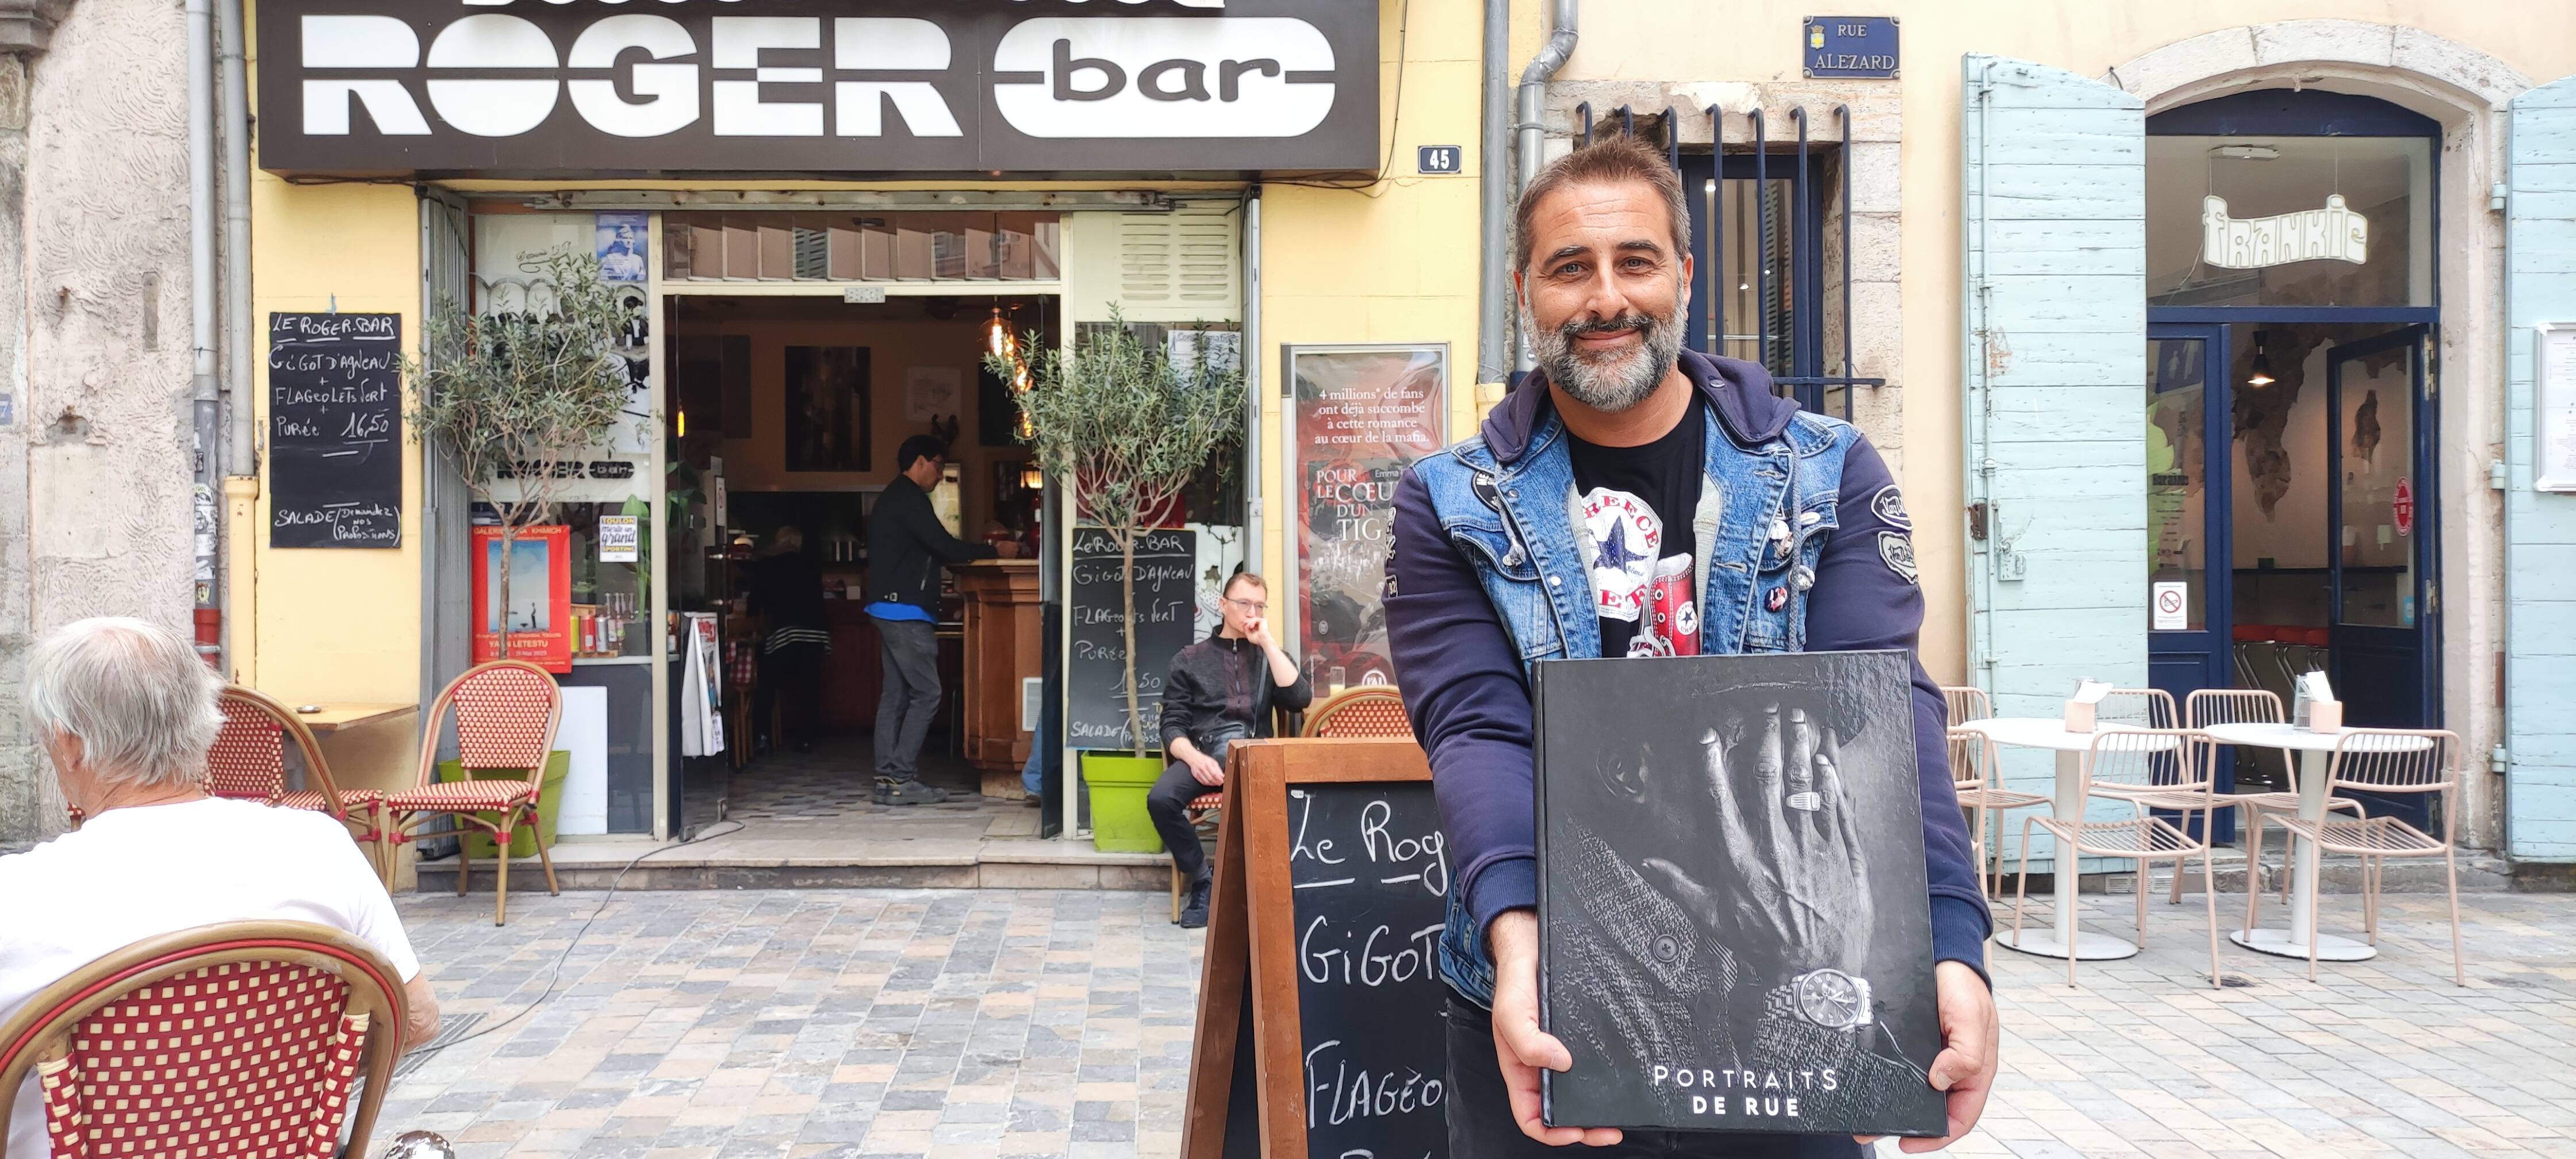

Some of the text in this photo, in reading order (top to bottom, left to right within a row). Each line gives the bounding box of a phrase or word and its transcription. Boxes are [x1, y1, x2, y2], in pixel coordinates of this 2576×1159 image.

[1837, 24, 1868, 37] RUE
[1814, 53, 1895, 70] ALEZARD
[301, 13, 1281, 137] ROGER bar
[1429, 149, 1450, 170] 45
[273, 313, 297, 331] LE
[1319, 389, 1327, 400] 4
[1384, 387, 1398, 399] de
[1401, 387, 1424, 399] fans
[1318, 401, 1425, 417] ont déjà succombé
[1327, 417, 1418, 429] à cette romance
[1314, 430, 1430, 444] au cœur de la mafia.
[597, 464, 629, 474] bar
[1317, 469, 1400, 484] POUR Emma
[1317, 481, 1400, 504] LE CŒU
[1336, 503, 1374, 518] D'UN
[1583, 494, 1660, 549] REECE
[601, 529, 636, 547] grand
[1290, 793, 1346, 864] Le
[1654, 1065, 1837, 1091] PORTRAITS
[1693, 1096, 1799, 1117] DE RUE
